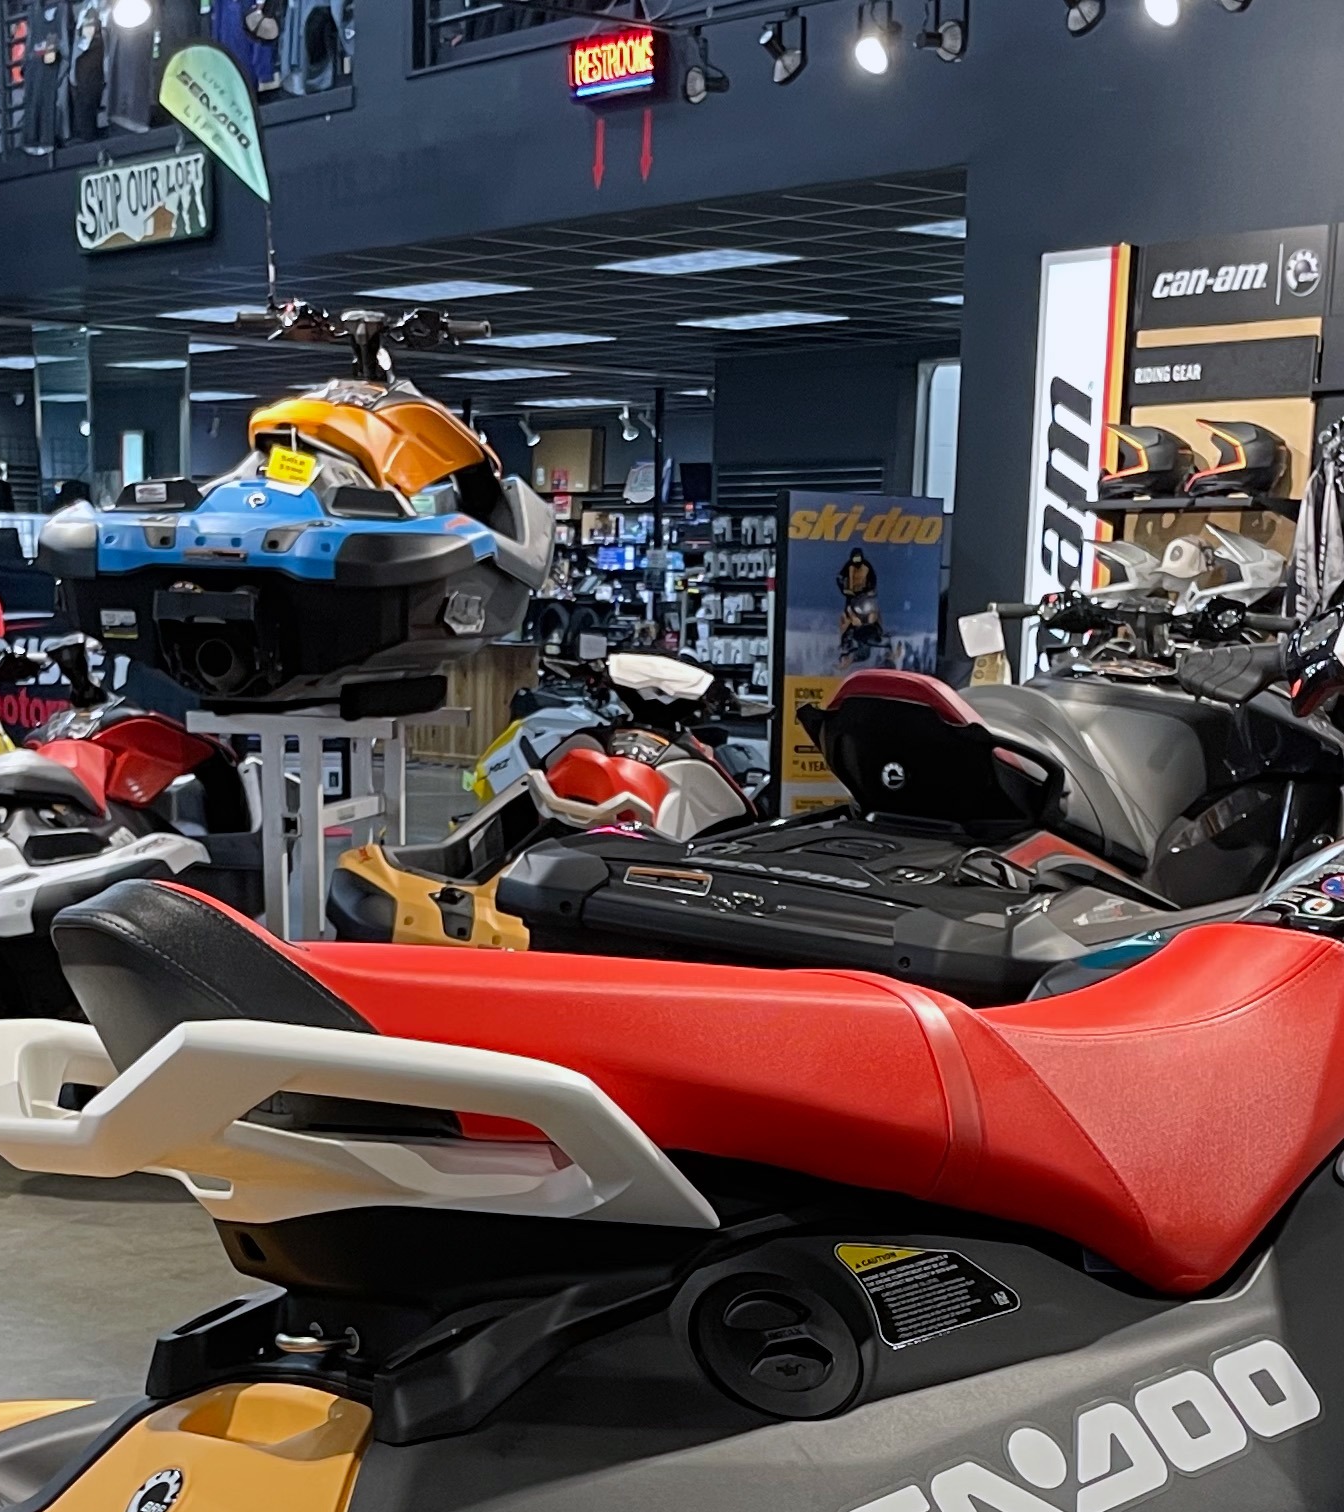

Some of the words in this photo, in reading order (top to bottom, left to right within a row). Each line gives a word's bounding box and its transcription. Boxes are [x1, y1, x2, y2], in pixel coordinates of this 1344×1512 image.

[78, 173, 122, 243] SHOP
[127, 166, 162, 217] OUR
[165, 157, 203, 194] LOFT
[1152, 262, 1269, 298] can-am
[1134, 365, 1170, 385] RIDING
[1172, 363, 1202, 383] GEAR
[788, 503, 943, 545] ski-doo
[862, 1252, 897, 1267] CAUTION
